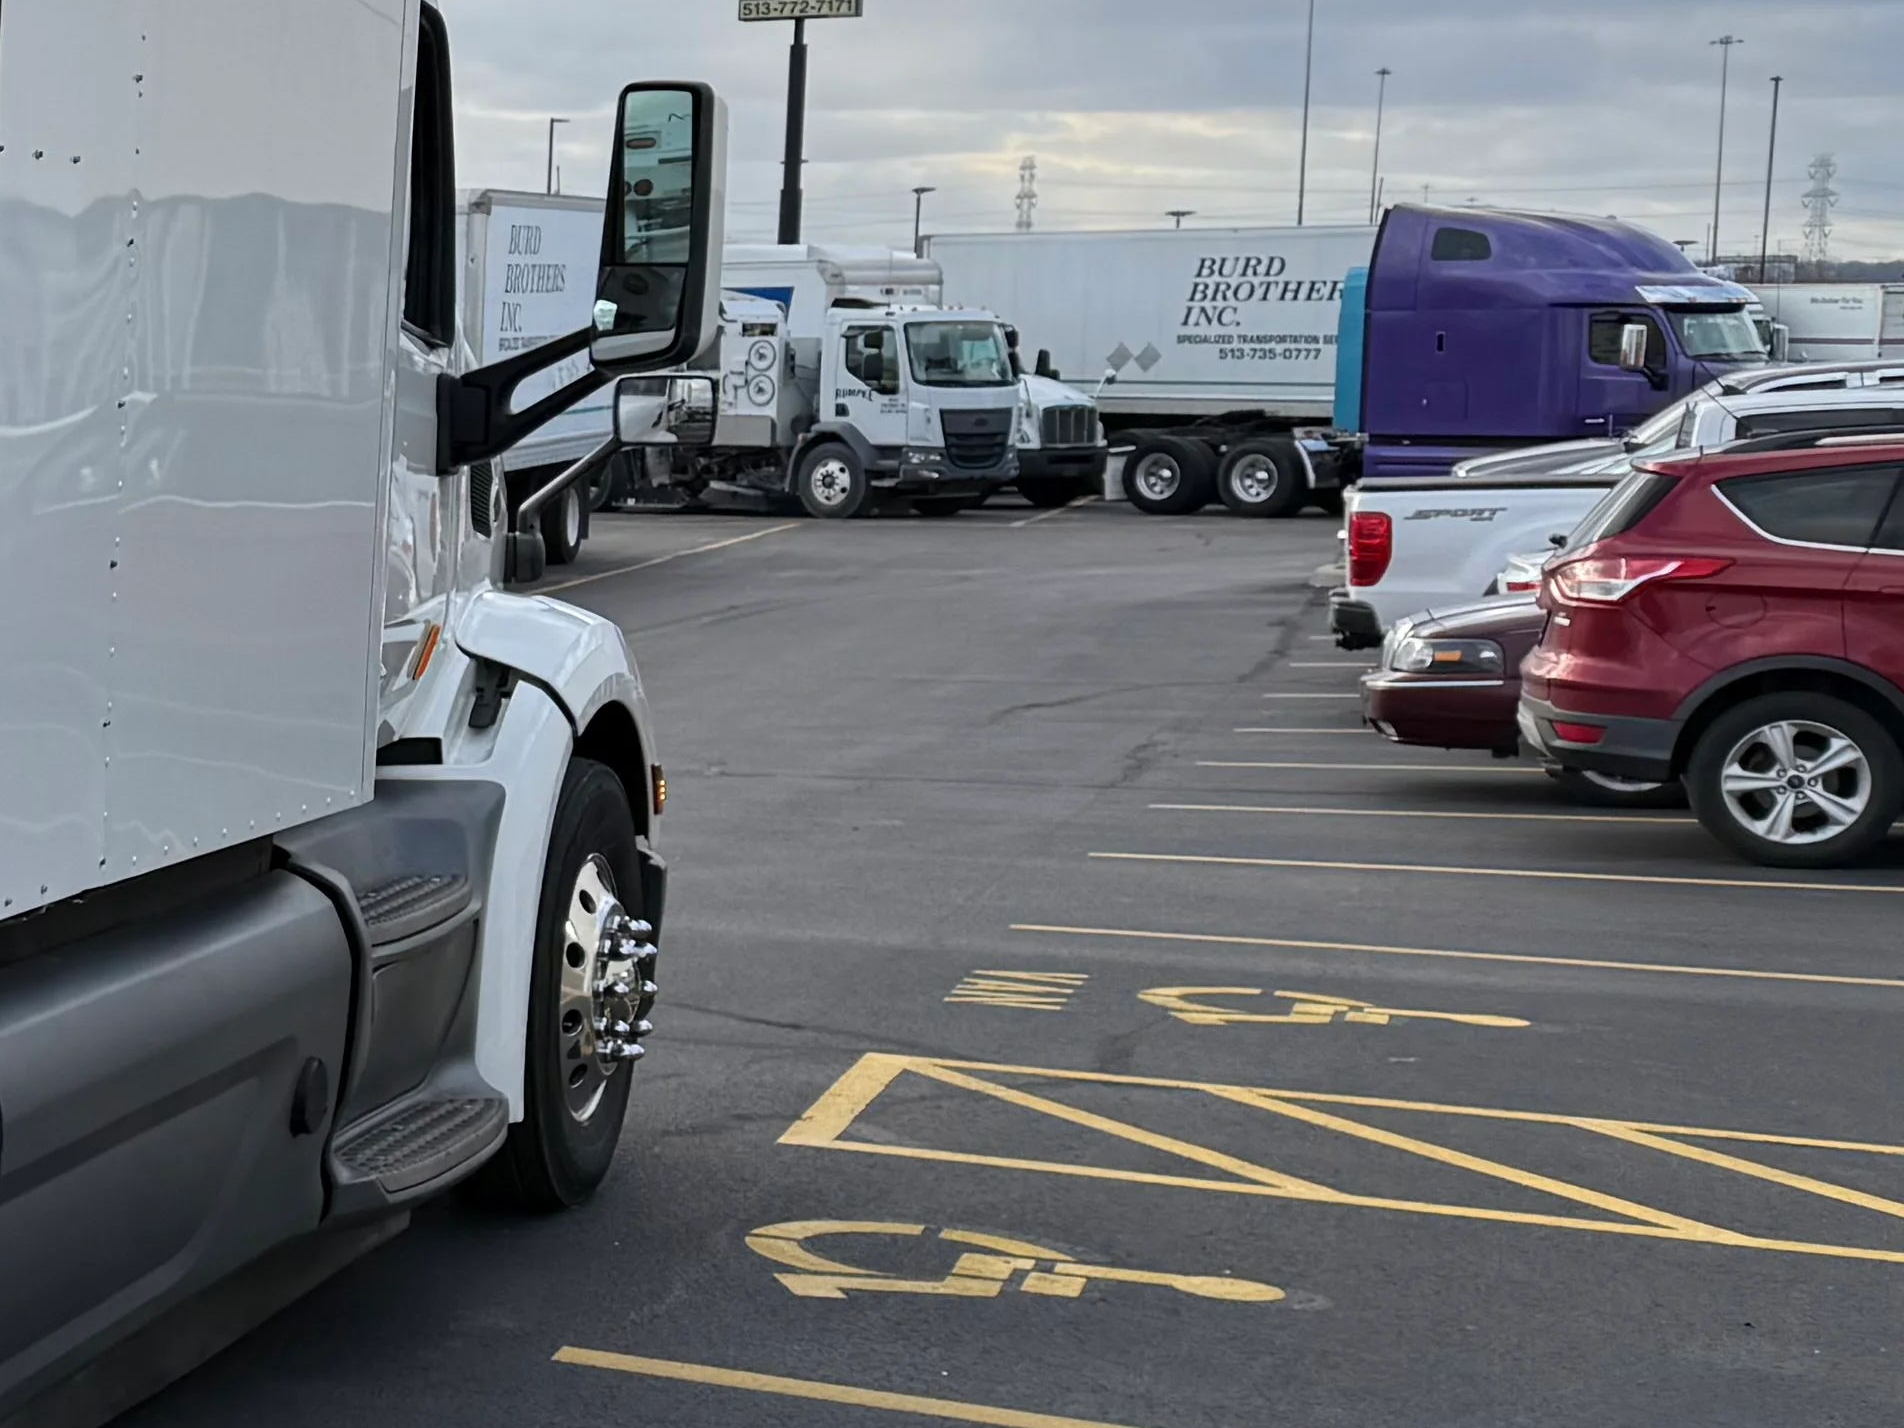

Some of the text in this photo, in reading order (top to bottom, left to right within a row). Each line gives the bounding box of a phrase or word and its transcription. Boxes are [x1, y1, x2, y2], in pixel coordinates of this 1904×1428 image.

[742, 0, 853, 16] 513-772-7171
[508, 224, 542, 256] BURD
[1194, 256, 1286, 278] BURD
[504, 263, 567, 294] BROTHERS
[1180, 305, 1241, 327] INC.
[1177, 334, 1234, 345] SPECIALIZED
[1237, 334, 1320, 345] TRANSPORTATION
[1218, 348, 1322, 360] 513-735-0777
